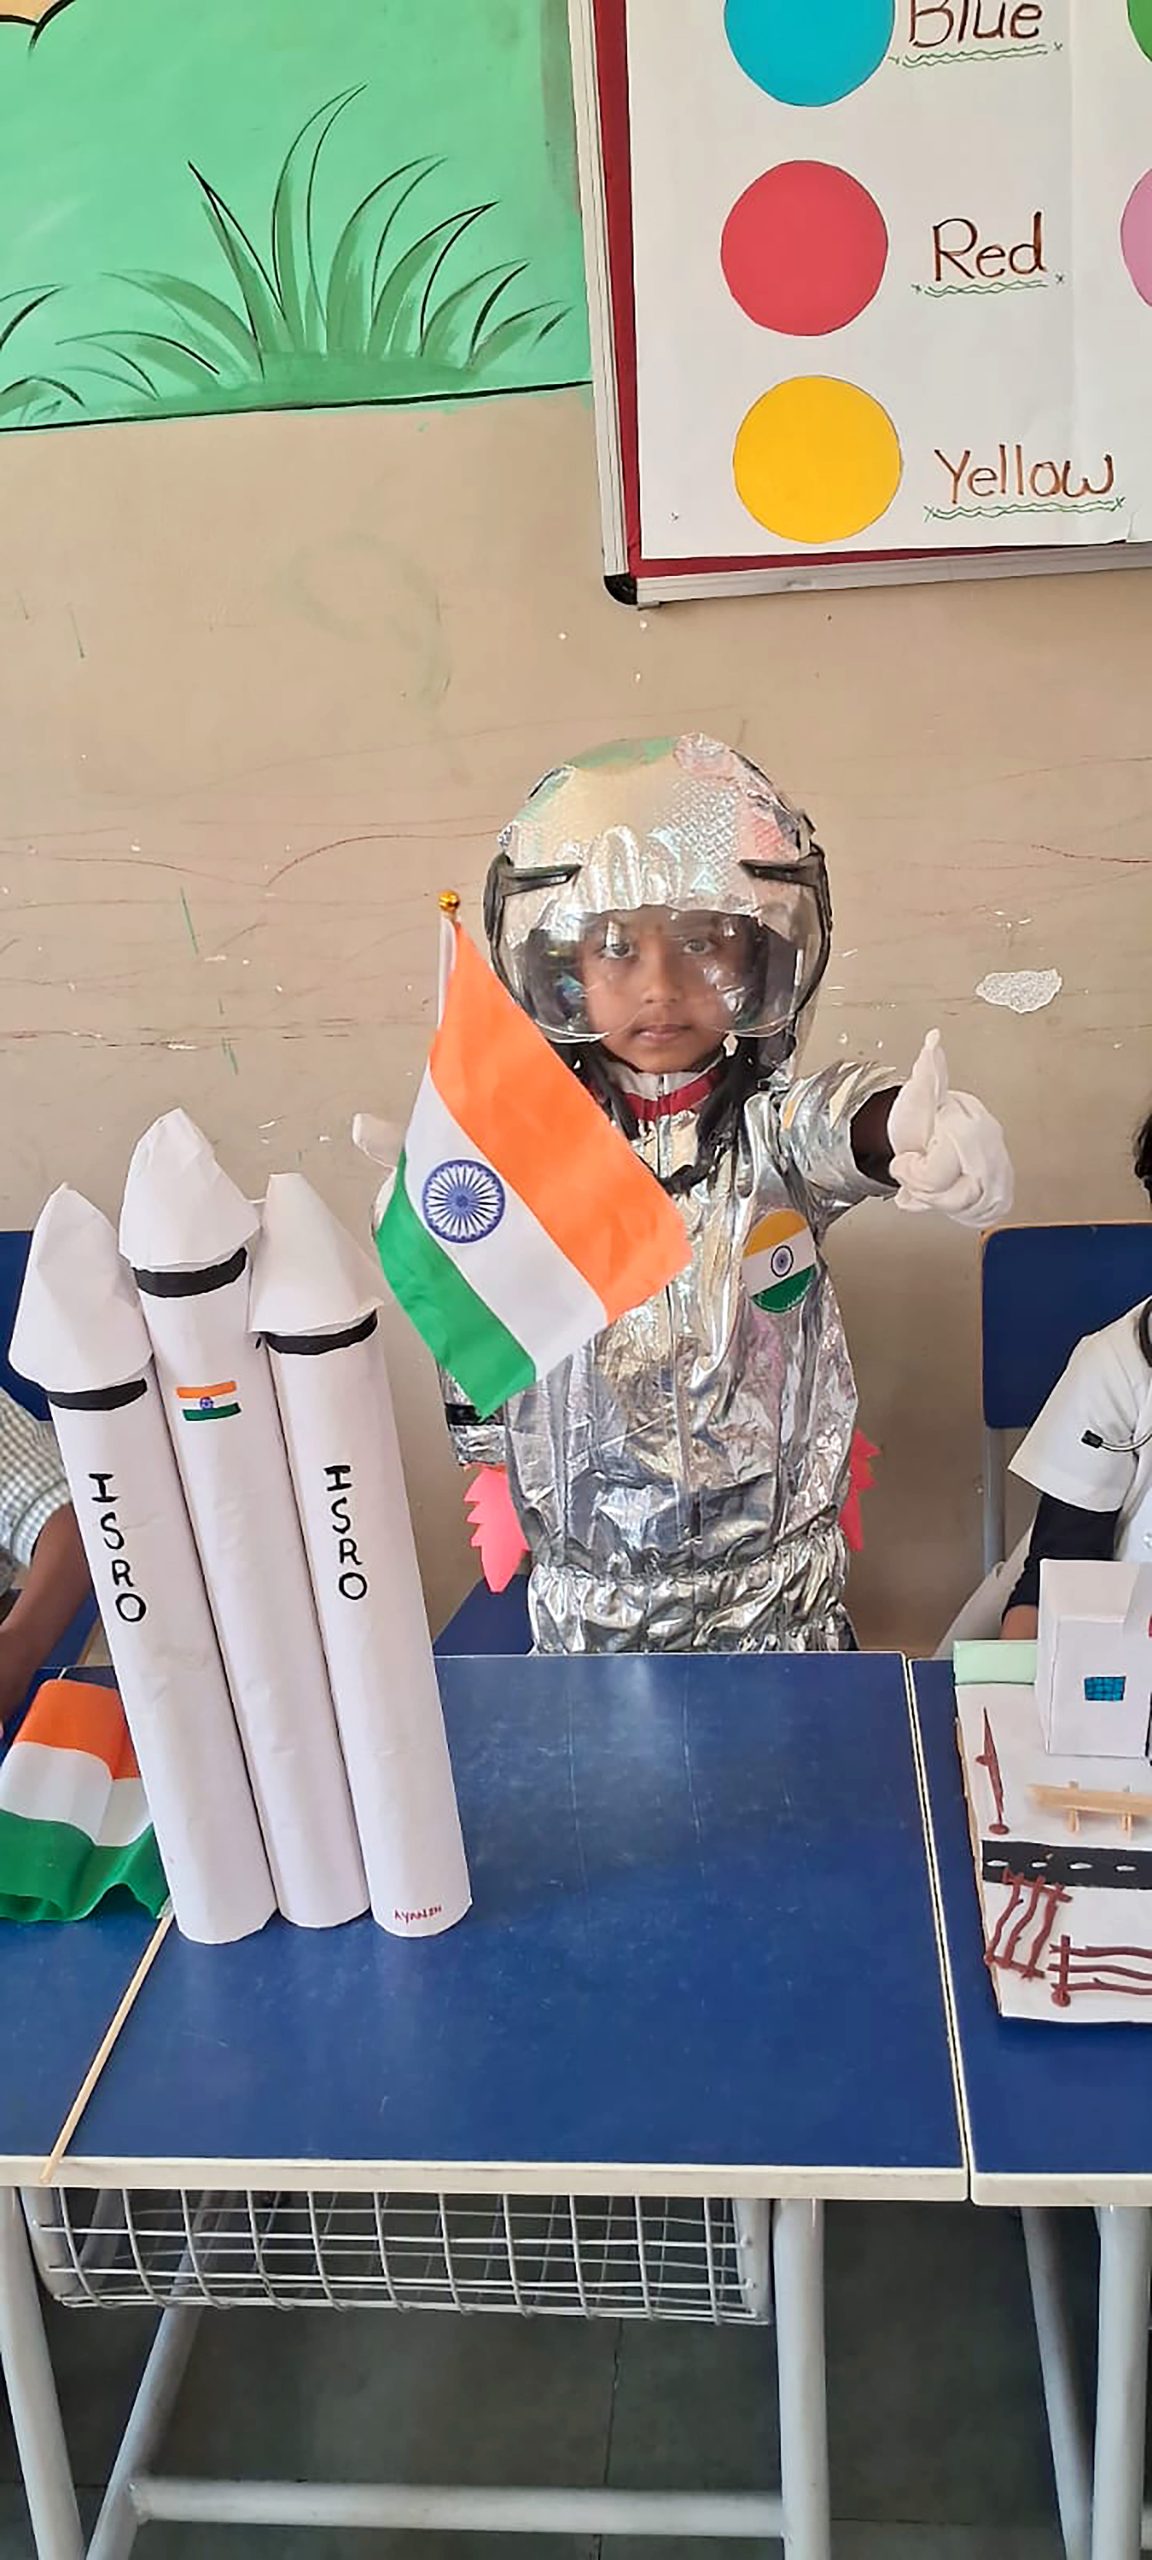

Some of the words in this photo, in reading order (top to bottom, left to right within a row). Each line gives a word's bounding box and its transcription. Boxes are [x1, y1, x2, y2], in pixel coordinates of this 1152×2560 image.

[908, 0, 1043, 48] Blue
[931, 211, 1047, 281] Red
[934, 444, 1115, 504] Yellow
[88, 1472, 147, 1623] ISRO
[324, 1464, 368, 1600] ISRO
